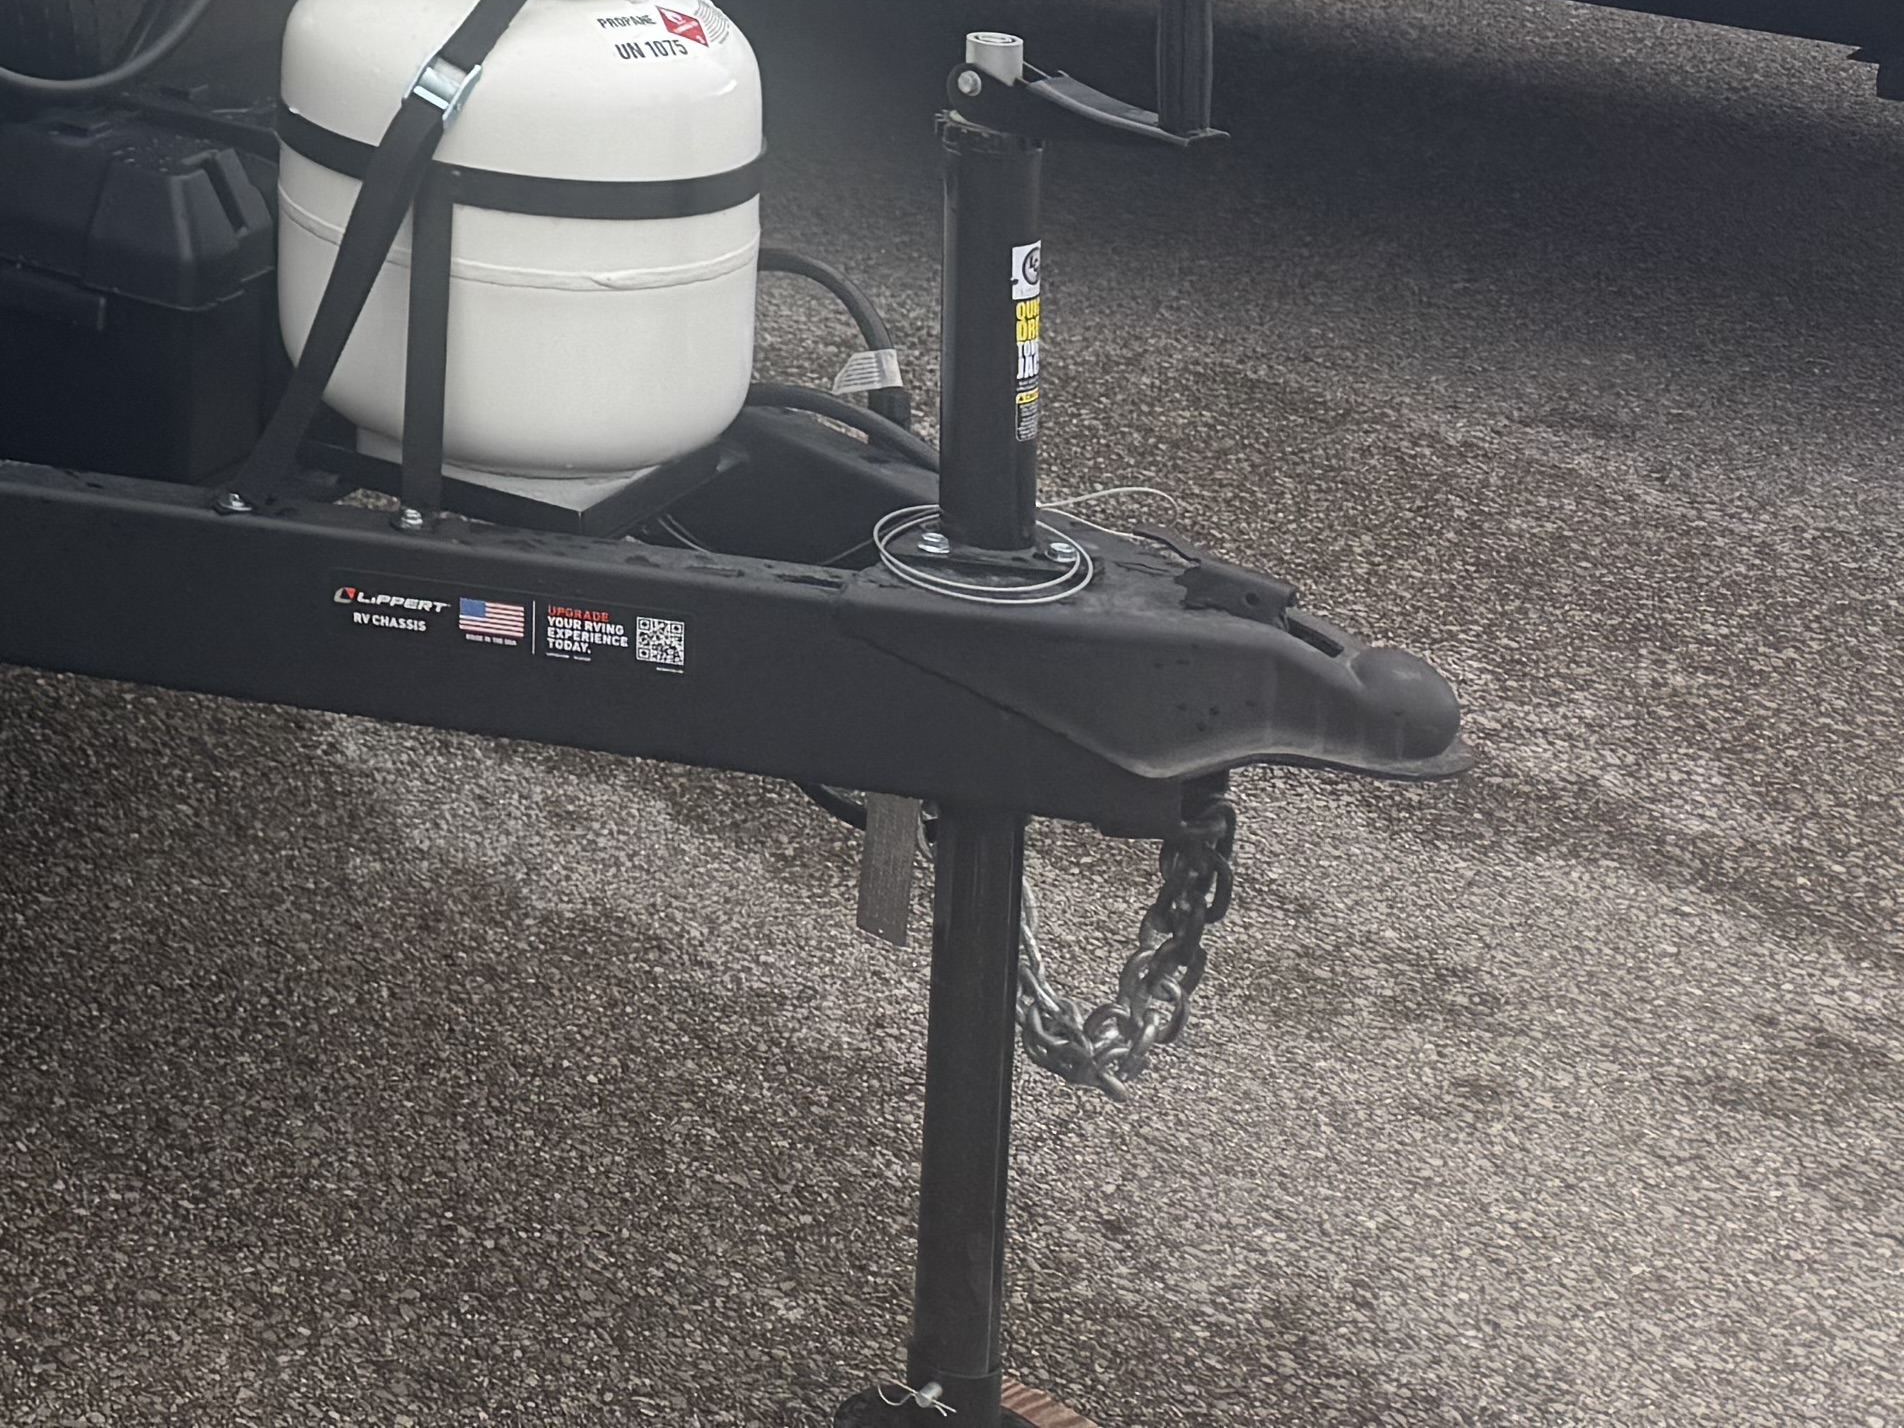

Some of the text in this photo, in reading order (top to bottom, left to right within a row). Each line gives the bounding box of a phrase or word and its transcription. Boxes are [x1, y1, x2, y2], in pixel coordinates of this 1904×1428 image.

[597, 14, 657, 29] PROPANE
[615, 39, 689, 60] UN 1075
[353, 612, 427, 632] RV CHASSIS
[547, 605, 610, 623] UPGRADE
[547, 616, 625, 636] YOUR RVING
[547, 627, 629, 648] EXPERIENCE
[547, 638, 592, 654] TODAY.
